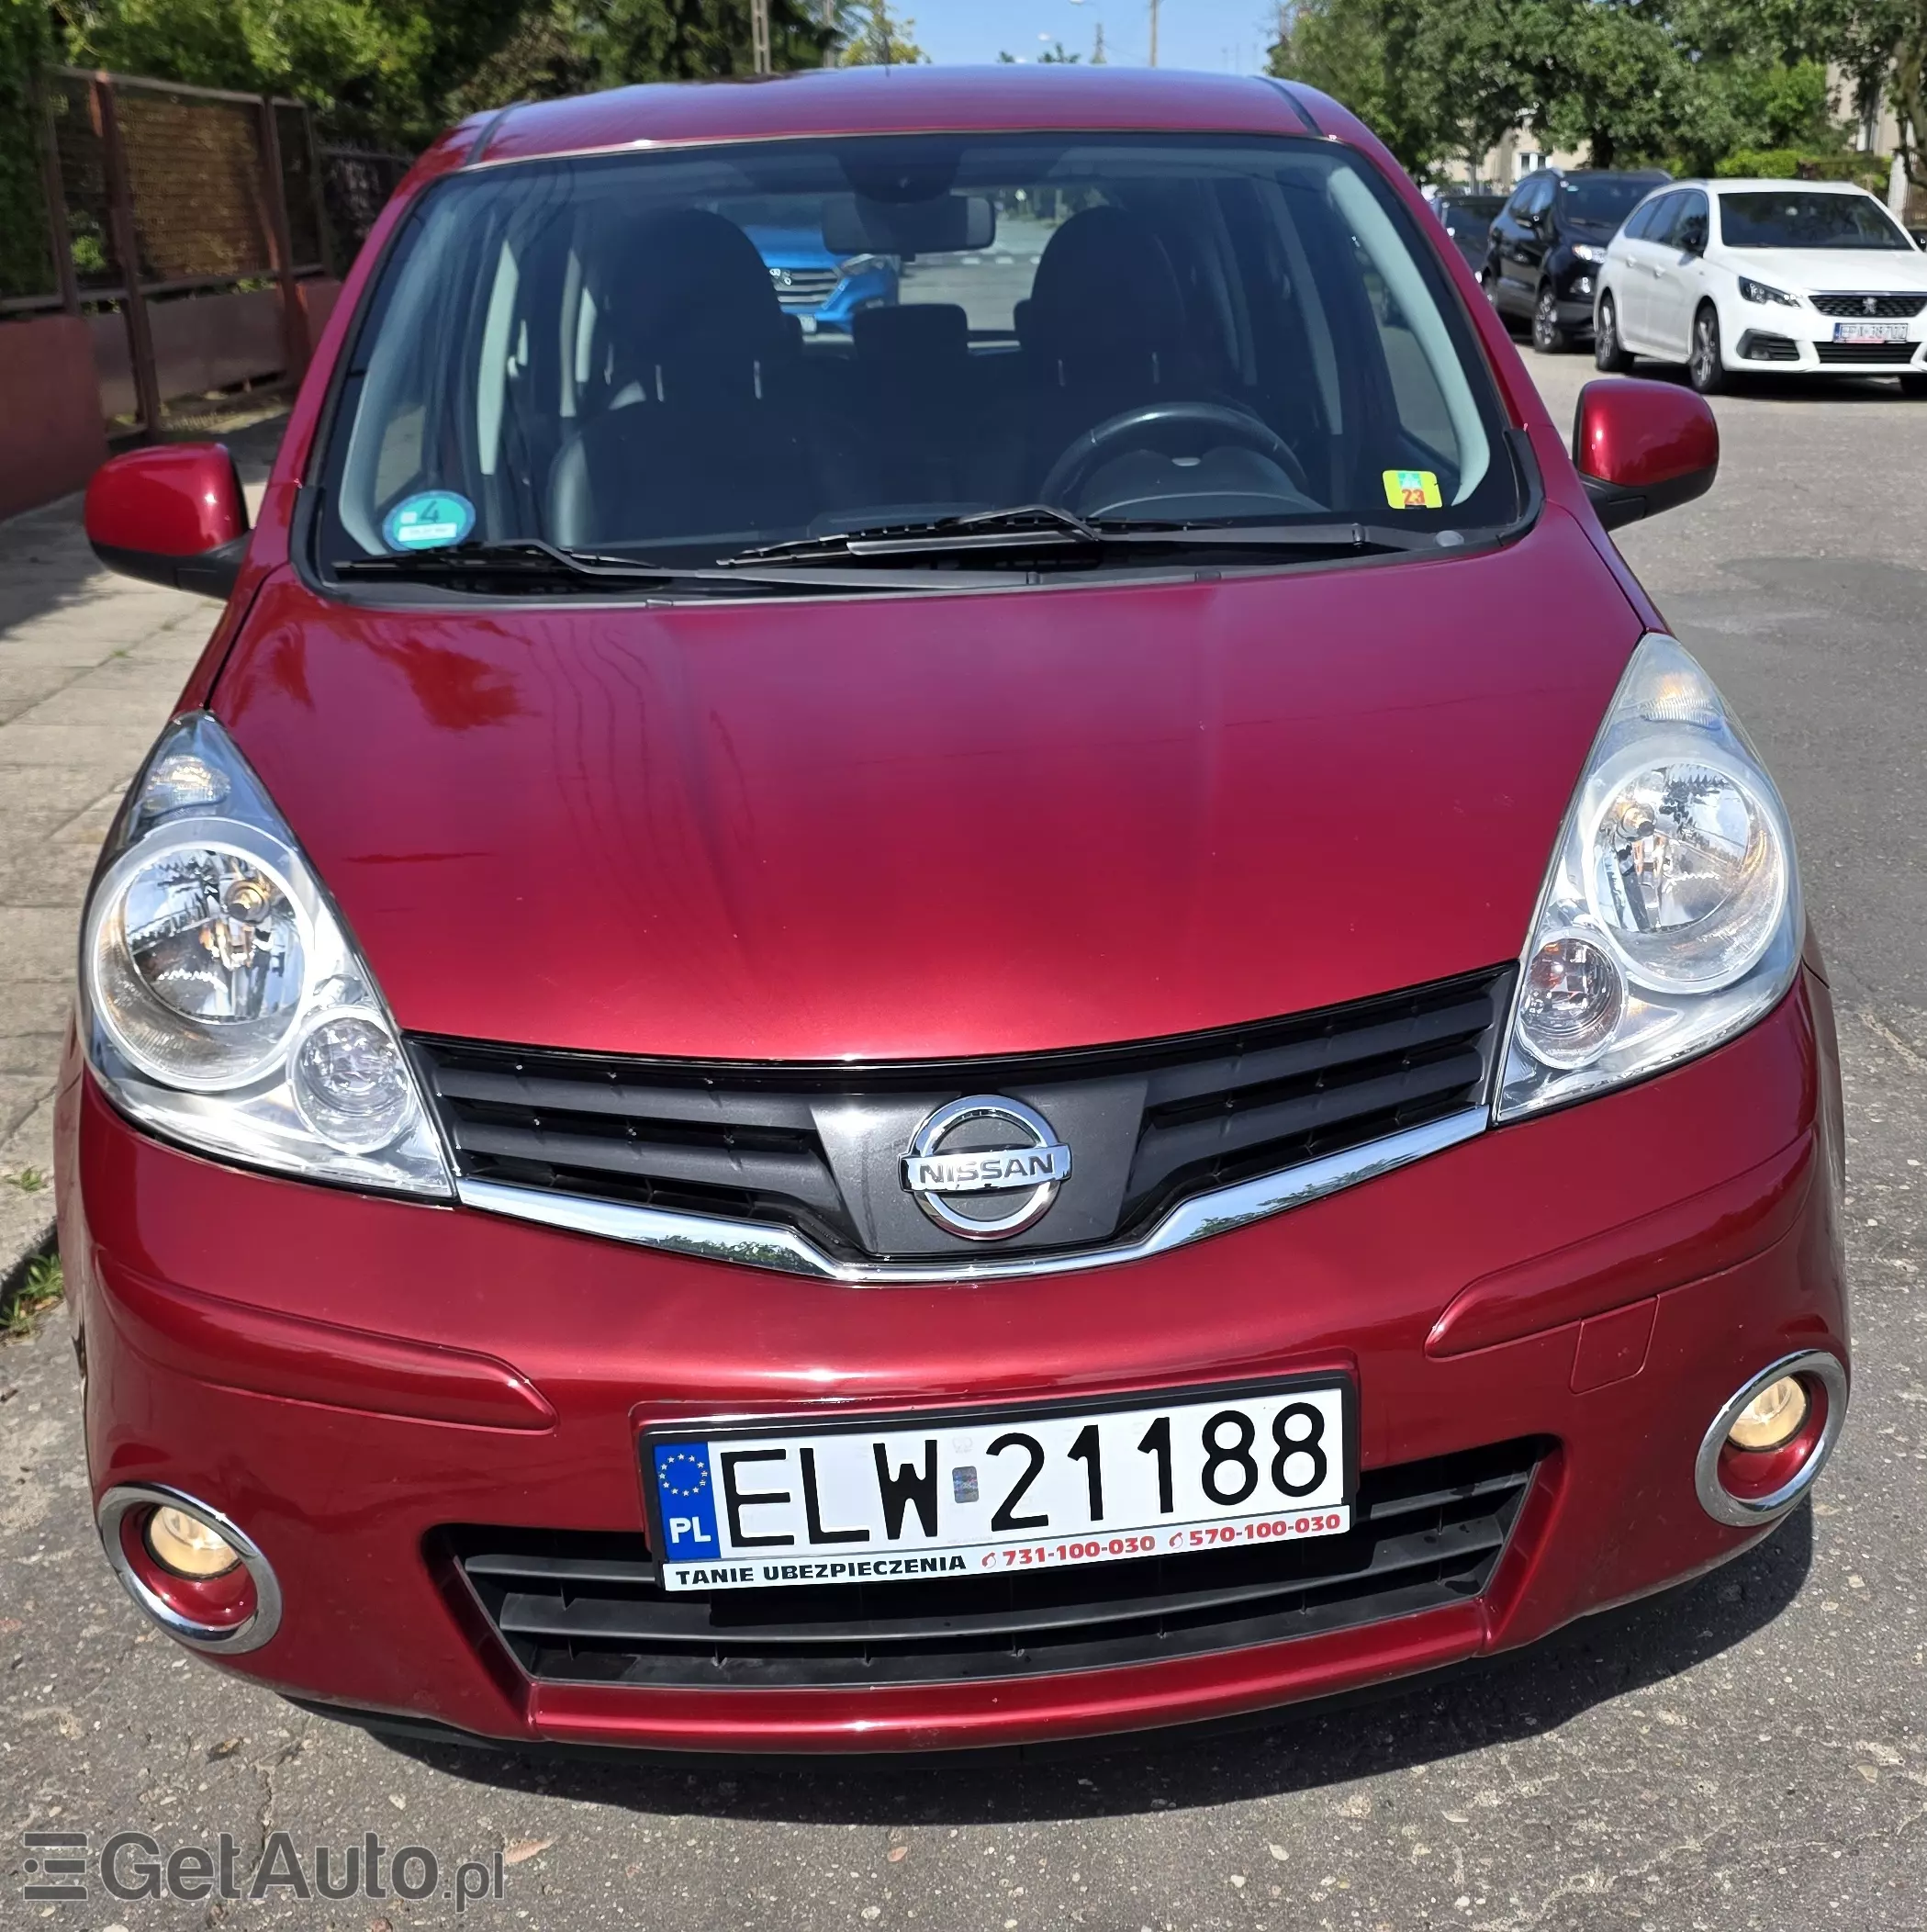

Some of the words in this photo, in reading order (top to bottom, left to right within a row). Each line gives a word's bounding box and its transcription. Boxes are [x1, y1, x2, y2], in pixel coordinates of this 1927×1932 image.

[419, 500, 440, 522] 4
[1401, 489, 1426, 504] 23
[919, 1153, 1054, 1184] NISSAN
[720, 1439, 937, 1548] ELW
[985, 1402, 1328, 1532] 21188
[669, 1516, 711, 1544] PL
[676, 1567, 754, 1585] TANIE
[764, 1556, 967, 1581] UBEZPIECZENIA
[1003, 1535, 1156, 1567] 731-100-030
[1189, 1514, 1340, 1545] 570-100-030
